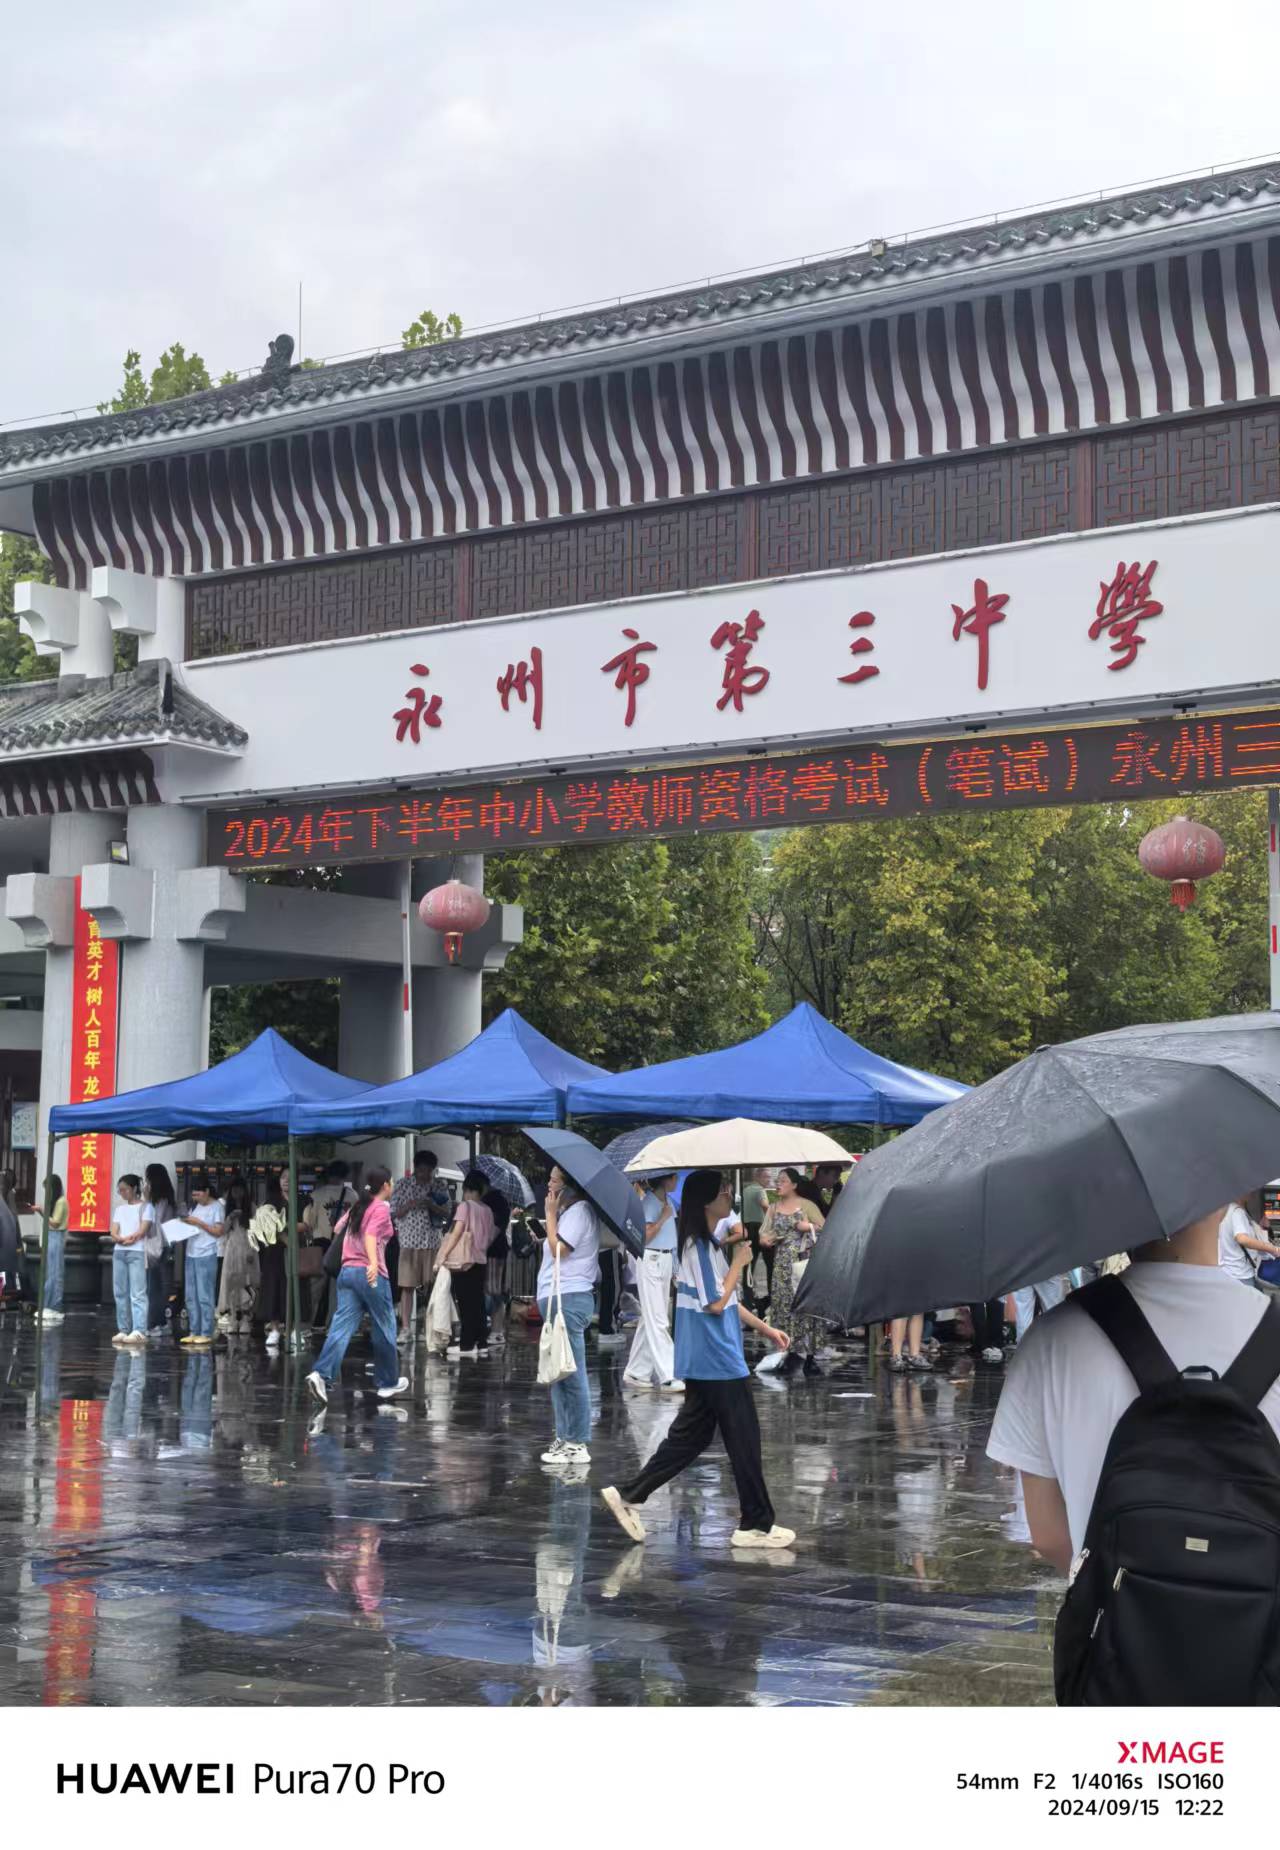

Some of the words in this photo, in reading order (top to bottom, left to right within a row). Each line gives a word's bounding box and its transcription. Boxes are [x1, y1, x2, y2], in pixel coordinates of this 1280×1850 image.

[392, 559, 1164, 744] 永州市第三中學
